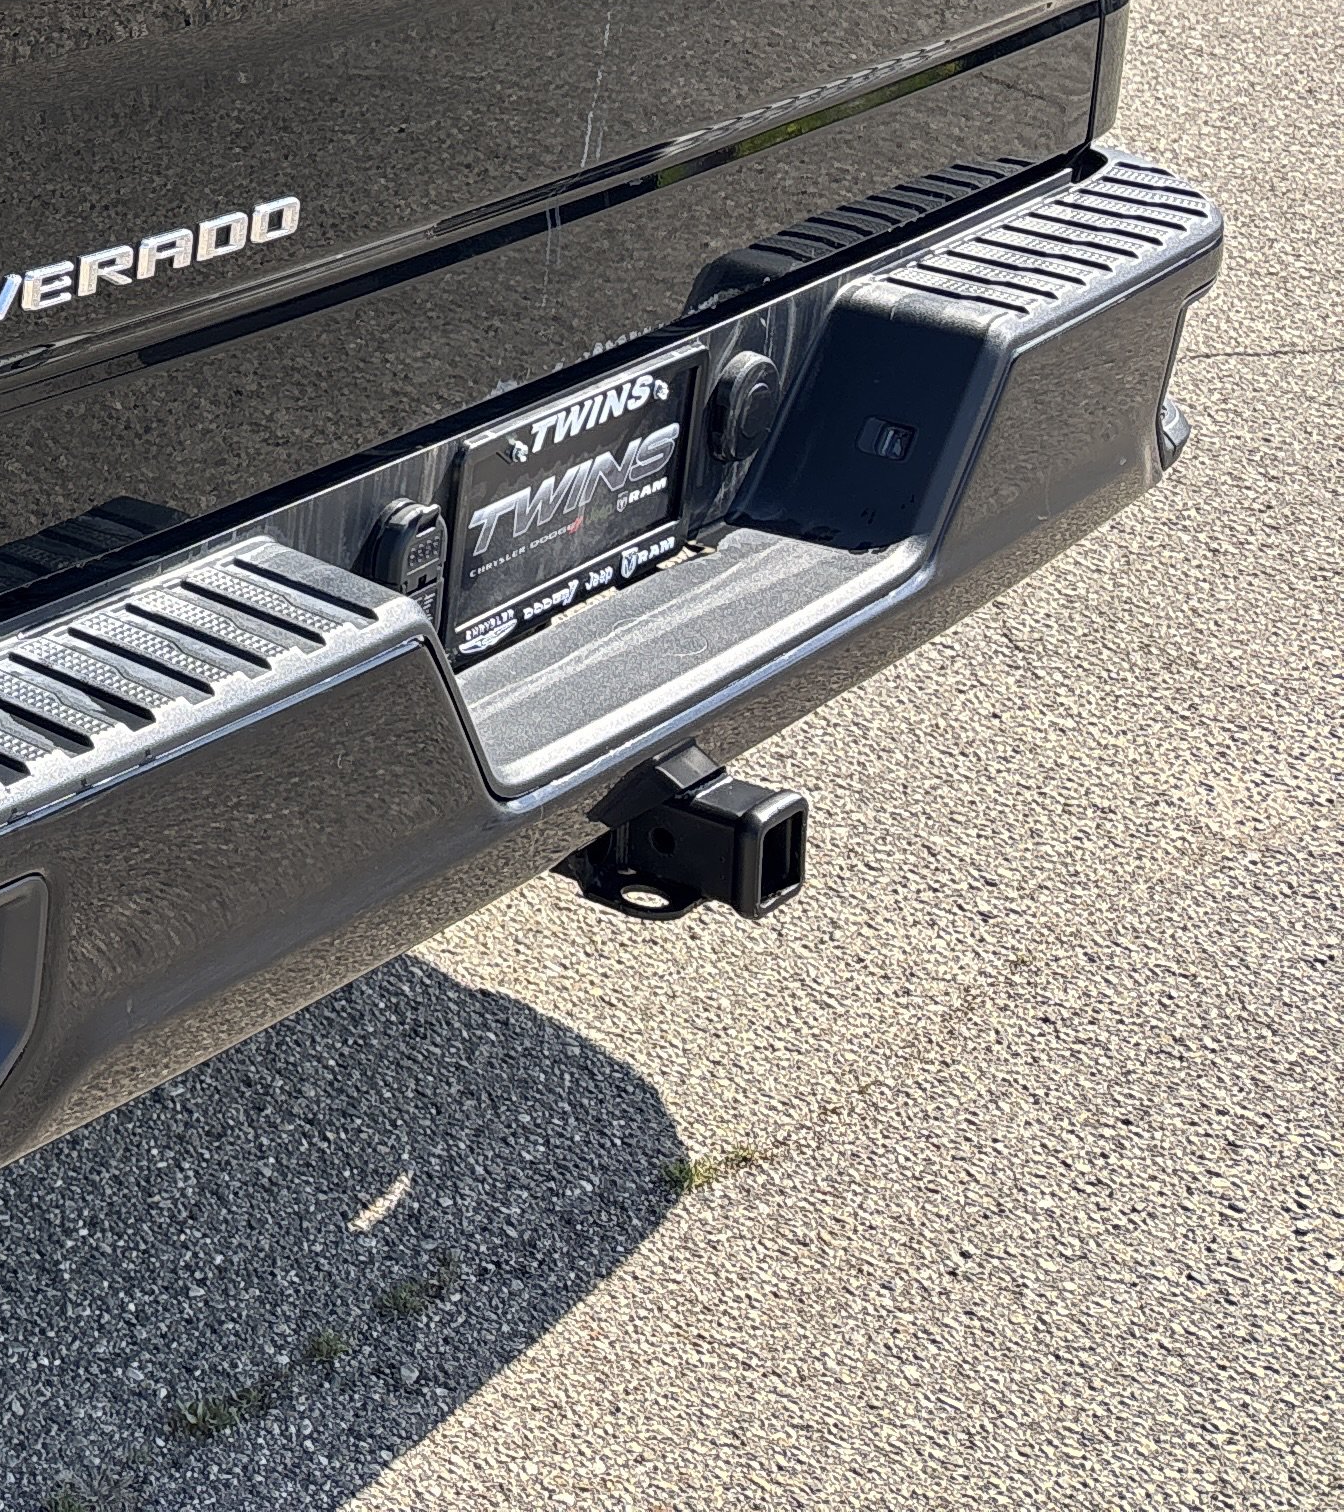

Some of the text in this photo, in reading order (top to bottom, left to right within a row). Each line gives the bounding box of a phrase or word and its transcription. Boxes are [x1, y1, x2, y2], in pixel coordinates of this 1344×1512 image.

[531, 374, 654, 454] TWINS
[468, 422, 680, 557] TWINS
[469, 546, 526, 578] CHRYSLER
[628, 476, 668, 504] RAM
[638, 536, 675, 565] RAM
